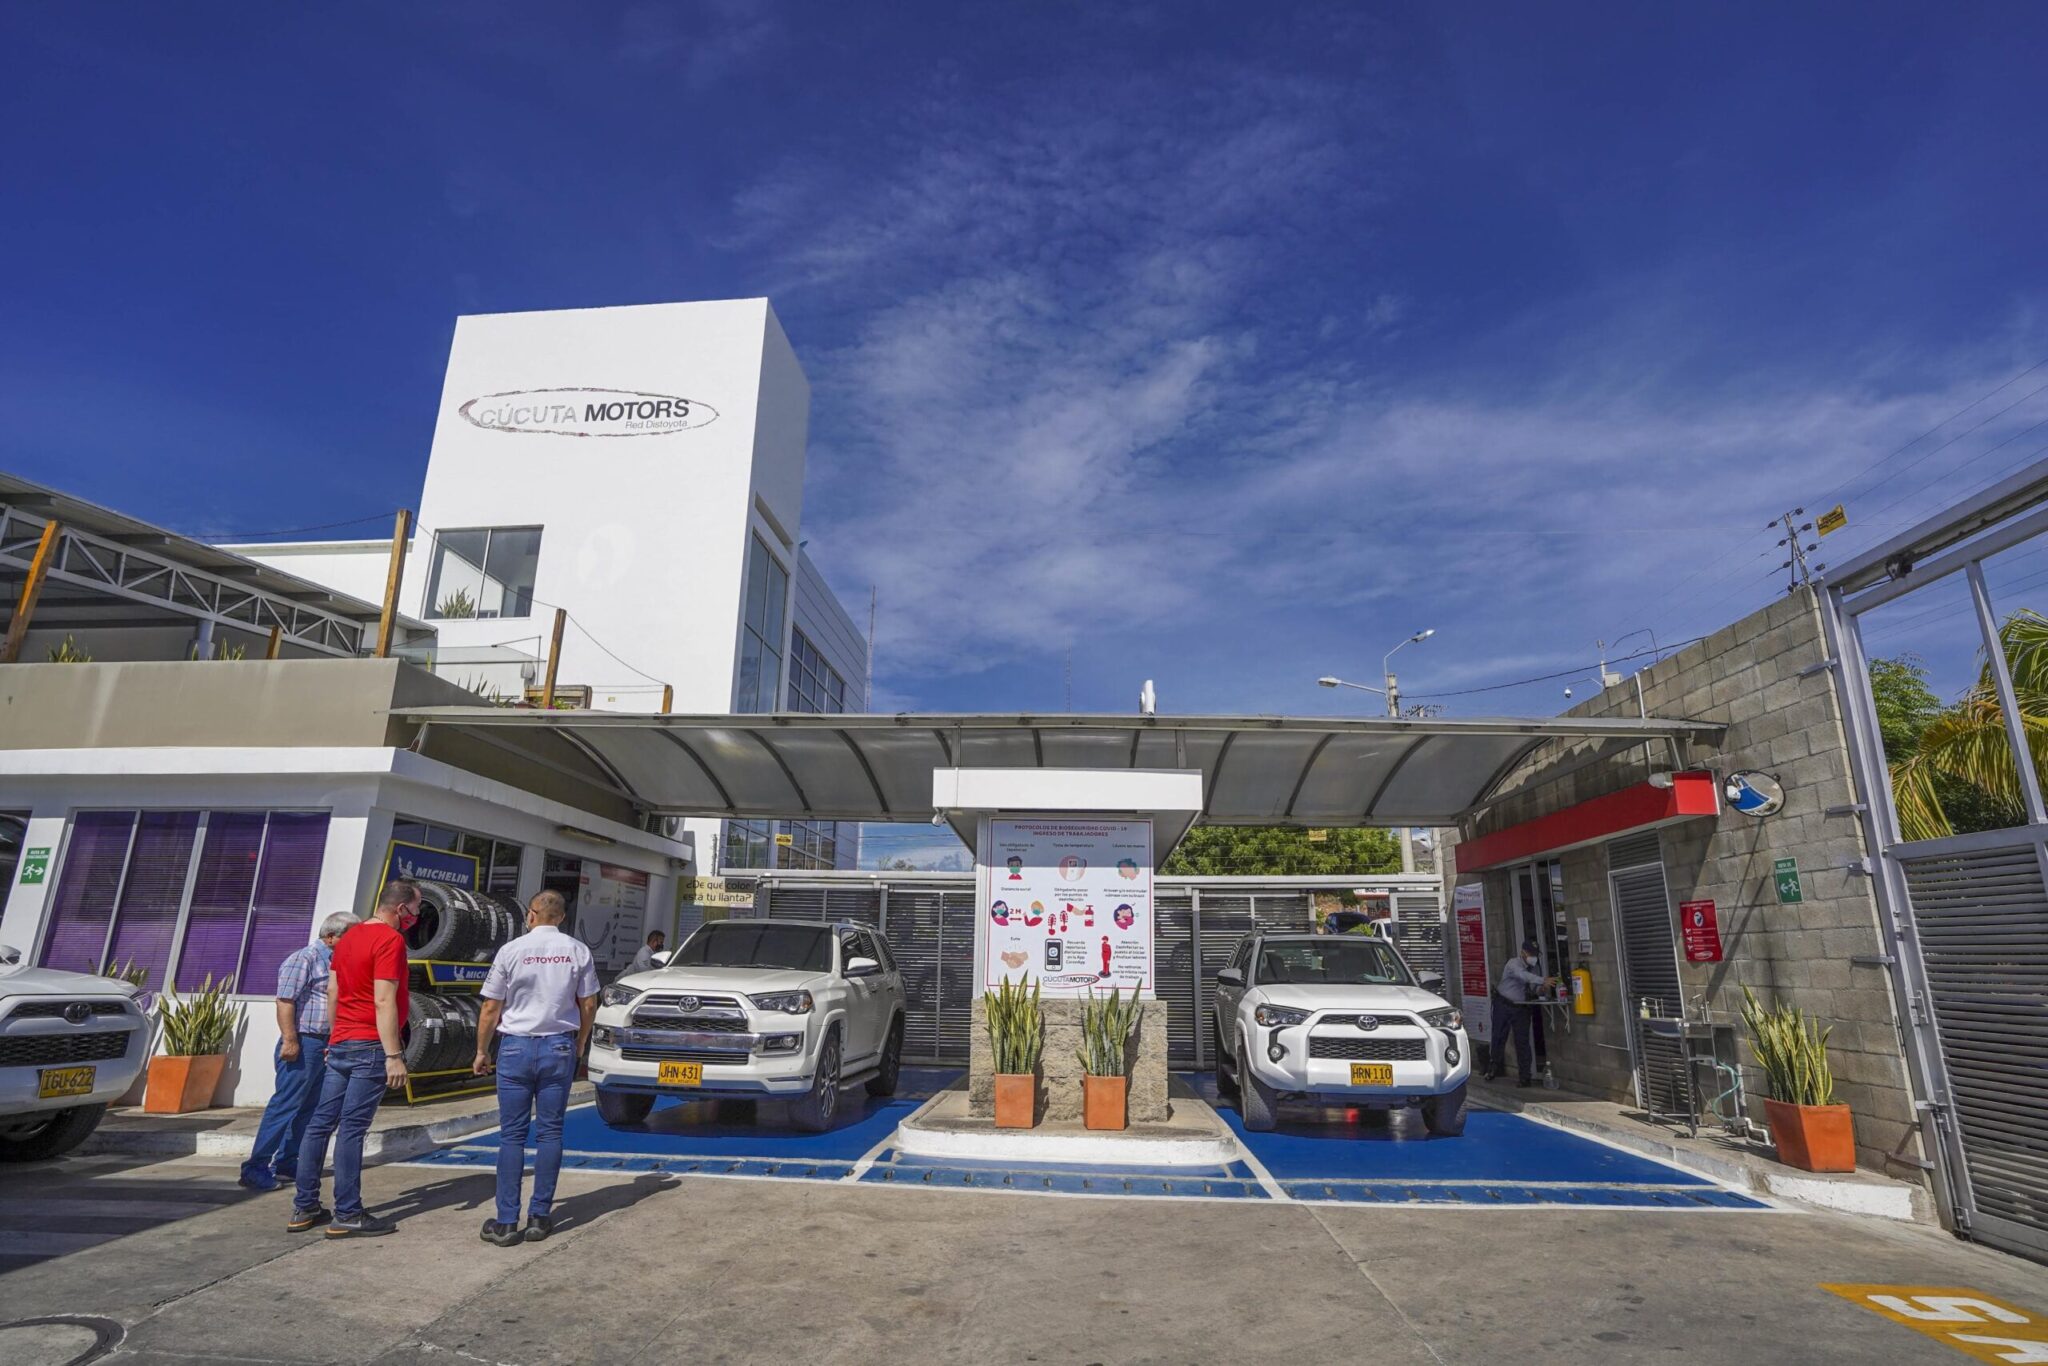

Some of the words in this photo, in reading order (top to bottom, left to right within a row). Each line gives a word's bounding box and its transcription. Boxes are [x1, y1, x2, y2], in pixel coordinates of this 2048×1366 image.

[479, 403, 577, 426] CÚCUTA
[584, 400, 690, 422] MOTORS
[625, 420, 644, 430] Red
[646, 419, 688, 430] Distoyota
[415, 867, 469, 884] MICHELIN
[706, 893, 716, 902] tu
[718, 893, 752, 903] llanta?
[535, 956, 571, 964] TOYOTA
